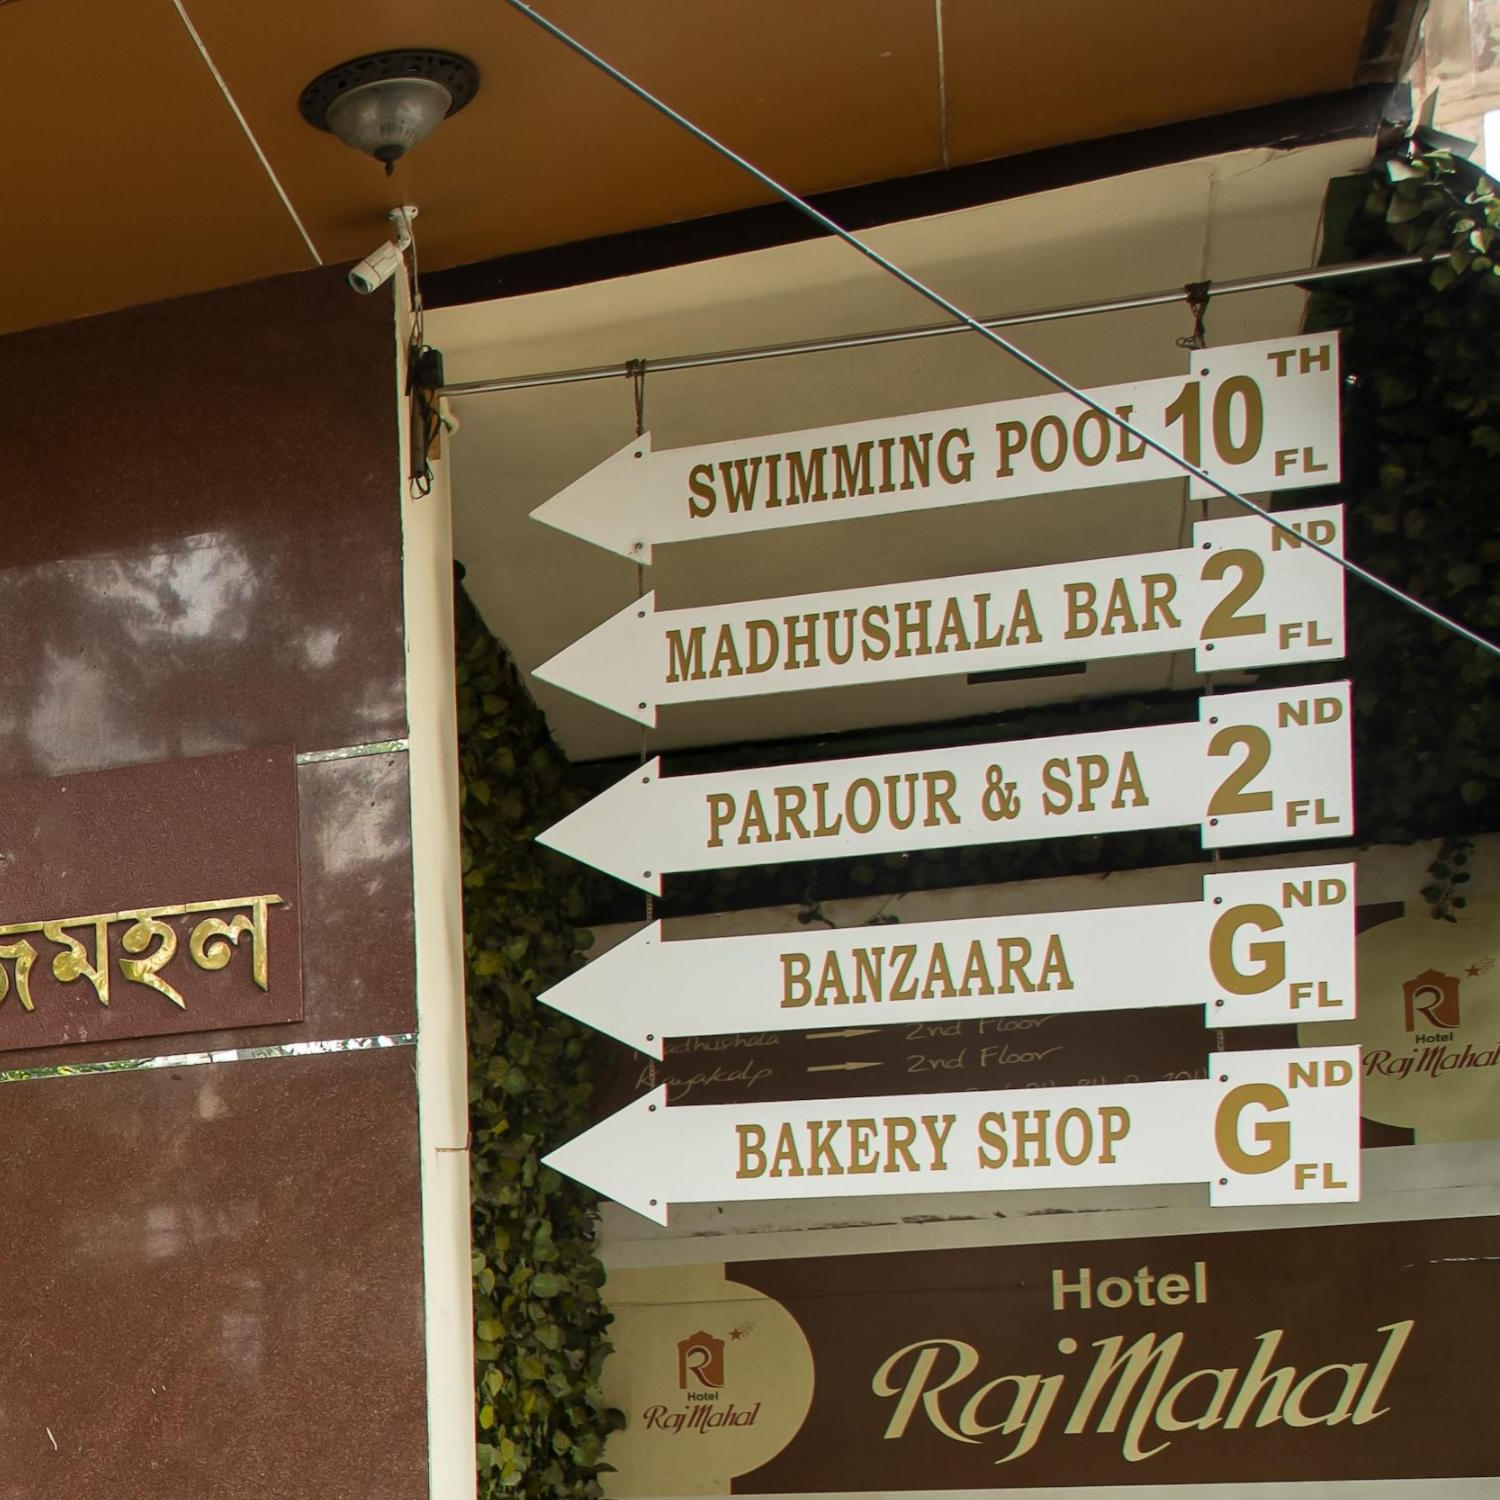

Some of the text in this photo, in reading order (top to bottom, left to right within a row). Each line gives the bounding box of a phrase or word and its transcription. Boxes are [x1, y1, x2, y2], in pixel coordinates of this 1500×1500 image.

[1266, 344, 1330, 377] TH
[687, 375, 1264, 519] SWIMMING POOL 10
[1274, 447, 1329, 477] FL
[1270, 518, 1337, 552] ND
[665, 548, 1266, 684] MADHUSHALA BAR 2
[1278, 621, 1333, 650] FL
[1277, 696, 1343, 728] ND
[706, 724, 1274, 848] PARLOUR & SPA 2
[1285, 799, 1340, 828] FL
[1282, 877, 1347, 909] ND
[779, 903, 1287, 1009] BANZAARA G
[1289, 981, 1343, 1009] FL
[634, 1027, 780, 1060] adhushala
[905, 1020, 960, 1040] 2nd
[1415, 1032, 1453, 1043] Hotel
[907, 1050, 964, 1073] 2nd
[980, 1046, 1063, 1067] Floor
[1287, 1059, 1353, 1091] ND
[735, 1084, 1292, 1179] BAKERY SHOP G
[1293, 1163, 1348, 1190] FL
[1051, 1261, 1207, 1310] Hotel
[687, 1391, 719, 1401] Hotel
